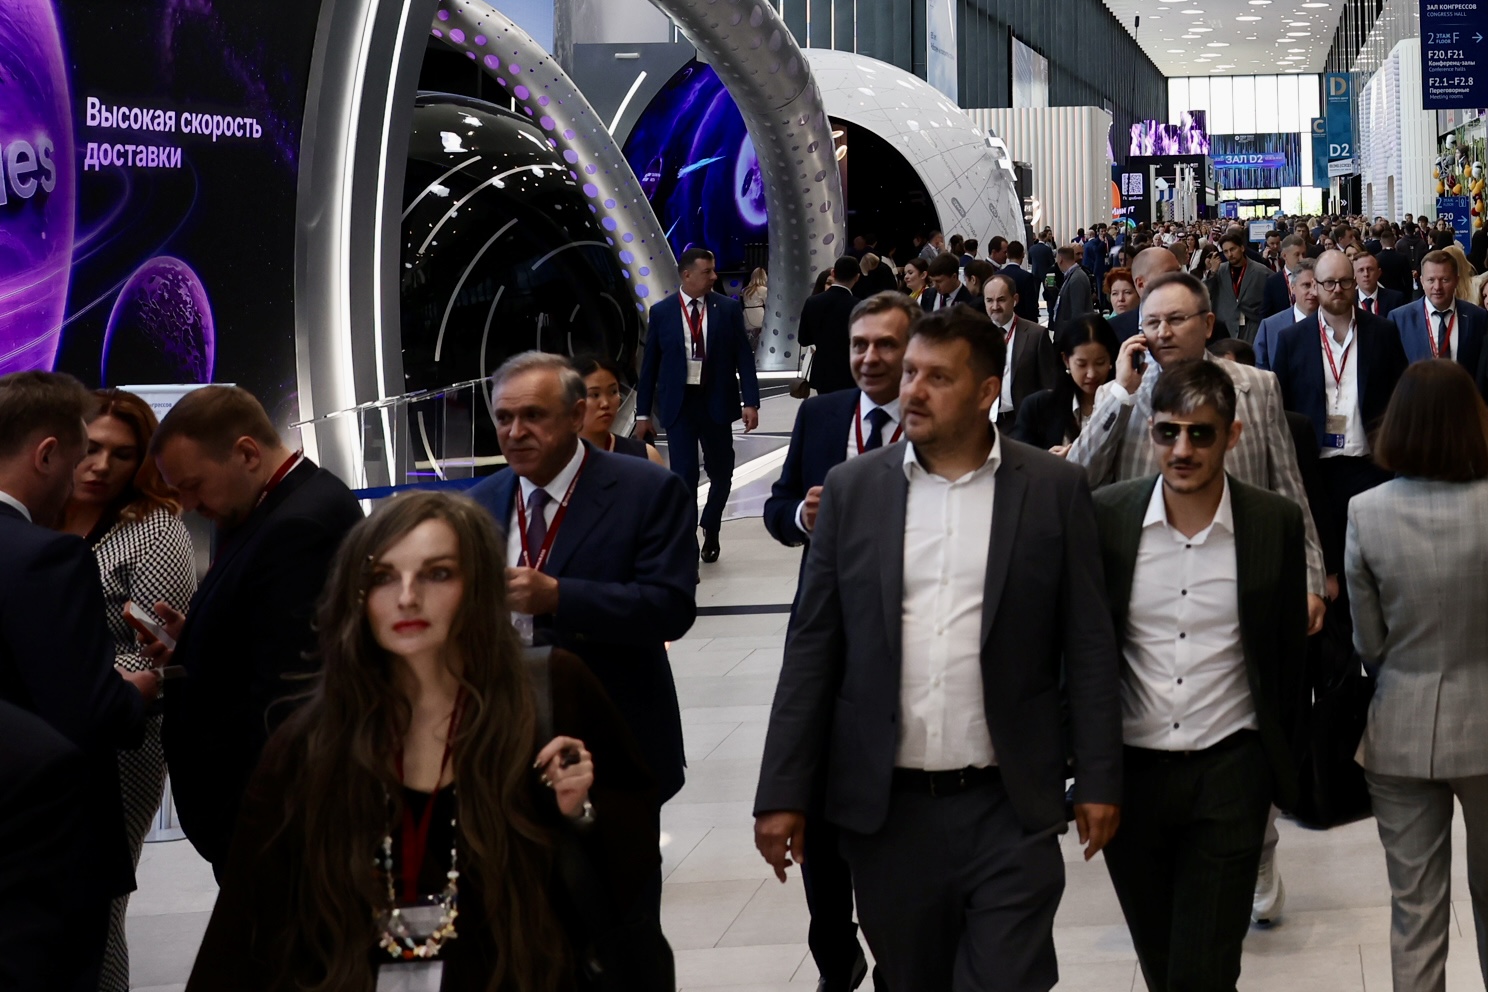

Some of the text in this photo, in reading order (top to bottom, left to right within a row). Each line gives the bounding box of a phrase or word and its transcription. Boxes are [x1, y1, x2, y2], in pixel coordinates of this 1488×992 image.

[1428, 32, 1434, 44] 2
[1453, 32, 1460, 44] F
[1330, 77, 1347, 95] D
[86, 96, 263, 142] Высокая скорость
[1313, 120, 1325, 133] C
[84, 142, 182, 171] доставки
[1329, 143, 1350, 157] D2
[1225, 155, 1247, 164] ЗАЛ
[1249, 154, 1264, 163] D2
[0, 137, 57, 206] es
[1436, 197, 1443, 208] 2
